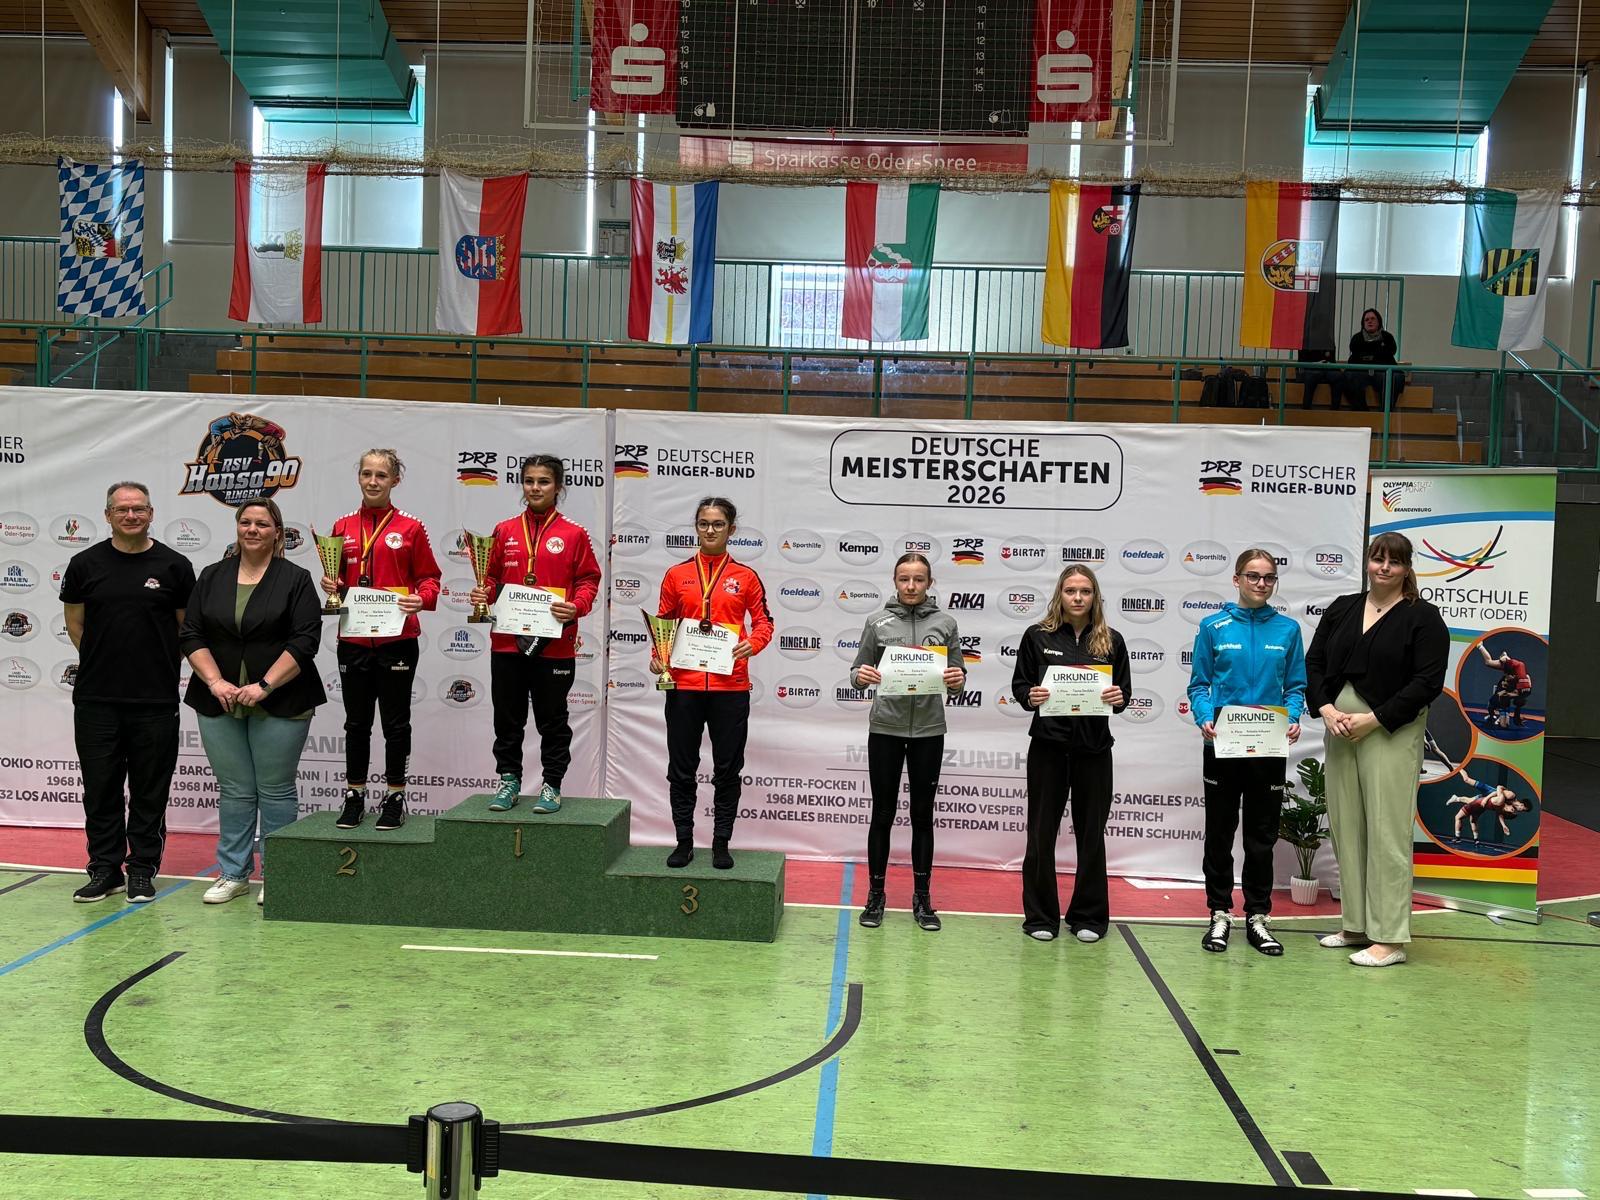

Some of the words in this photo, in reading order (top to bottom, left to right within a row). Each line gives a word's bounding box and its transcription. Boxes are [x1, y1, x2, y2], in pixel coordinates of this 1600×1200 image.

[976, 22, 984, 30] 11
[681, 30, 690, 39] 12
[976, 36, 986, 45] 12
[680, 46, 690, 54] 13
[976, 52, 985, 60] 13
[680, 61, 688, 70] 14
[975, 67, 984, 76] 14
[974, 84, 984, 92] 15
[764, 150, 861, 171] Sparkasse
[867, 152, 977, 172] Oder-Spree
[615, 444, 649, 460] DRB
[911, 436, 1040, 458] DEUTSCHE
[458, 451, 498, 468] DRB
[657, 448, 754, 464] DEUTSCHER
[222, 458, 252, 472] RSV
[506, 456, 604, 472] DECHER
[841, 456, 1110, 484] MEISTERSCHAFTEN
[1200, 460, 1242, 476] DRB
[656, 465, 756, 478] RINGER-BUND
[1252, 464, 1356, 480] DEUTSCHER
[506, 473, 604, 488] RIBUND
[224, 488, 261, 500] RINGEN
[947, 485, 1006, 504] 2026
[1251, 482, 1356, 496] RINGER-BUND
[618, 534, 650, 544] BIRTAT
[726, 538, 763, 547] oeldeak
[953, 538, 984, 550] DRB
[839, 542, 879, 556] Kempa
[905, 541, 930, 550] DOSB
[1012, 548, 1046, 558] BIRTAT
[1062, 548, 1105, 560] RINGEN.DE
[1122, 550, 1164, 560] foeldeak
[1196, 553, 1227, 562] Sporthilfe
[1316, 553, 1342, 563] DOSB
[616, 578, 640, 588] DOSB
[354, 594, 397, 602] URKUNDE
[508, 592, 553, 602] URKUNDE
[780, 587, 820, 597] foeldeak
[850, 591, 879, 600] Sporthilfe
[1008, 594, 1034, 602] DOSB
[1420, 588, 1528, 606] ORTSCHULE
[948, 592, 984, 609] RIKA
[1122, 598, 1165, 611] RINGEN.DE
[1480, 607, 1528, 622] (ODER)
[610, 630, 647, 643] Kempa
[780, 636, 820, 648] RINGEN.DE
[838, 640, 860, 648] foeld
[1000, 646, 1017, 656] Ke
[1044, 648, 1064, 656] Kempa
[1130, 652, 1164, 661] BIRTAT
[890, 654, 934, 662] URKUNDE
[1052, 672, 1099, 681] URKUNDE
[616, 681, 645, 689] Sporthilfe
[788, 687, 820, 696] BIRTAT
[836, 688, 876, 700] RINGEN.D
[1227, 712, 1275, 722] URKUNDE
[36, 760, 81, 770] ROTTER
[407, 774, 445, 787] GELES
[46, 776, 74, 786] 1968
[173, 782, 200, 791] 1968
[310, 787, 338, 798] 1960
[372, 790, 428, 802] DIRICH
[756, 776, 857, 790] ROTTER-FOCKEN
[1124, 794, 1182, 806] ANGELES
[1184, 796, 1206, 808] PAS
[16, 790, 38, 802] LOS
[40, 792, 85, 803] ANGEL
[168, 796, 194, 808] 1928
[196, 798, 220, 808] AMS
[766, 794, 794, 804] 1968
[796, 794, 846, 808] MEXIKO
[848, 798, 872, 808] MET
[979, 804, 1024, 816] VESPER
[760, 810, 815, 822] ANGELES
[817, 812, 871, 824] BRENDEL
[933, 818, 998, 830] MSTERDAM
[1002, 822, 1028, 832] LEU
[1104, 826, 1144, 838] ATHEN
[512, 828, 524, 858] 1
[336, 846, 358, 876] 2
[680, 884, 700, 914] 3
